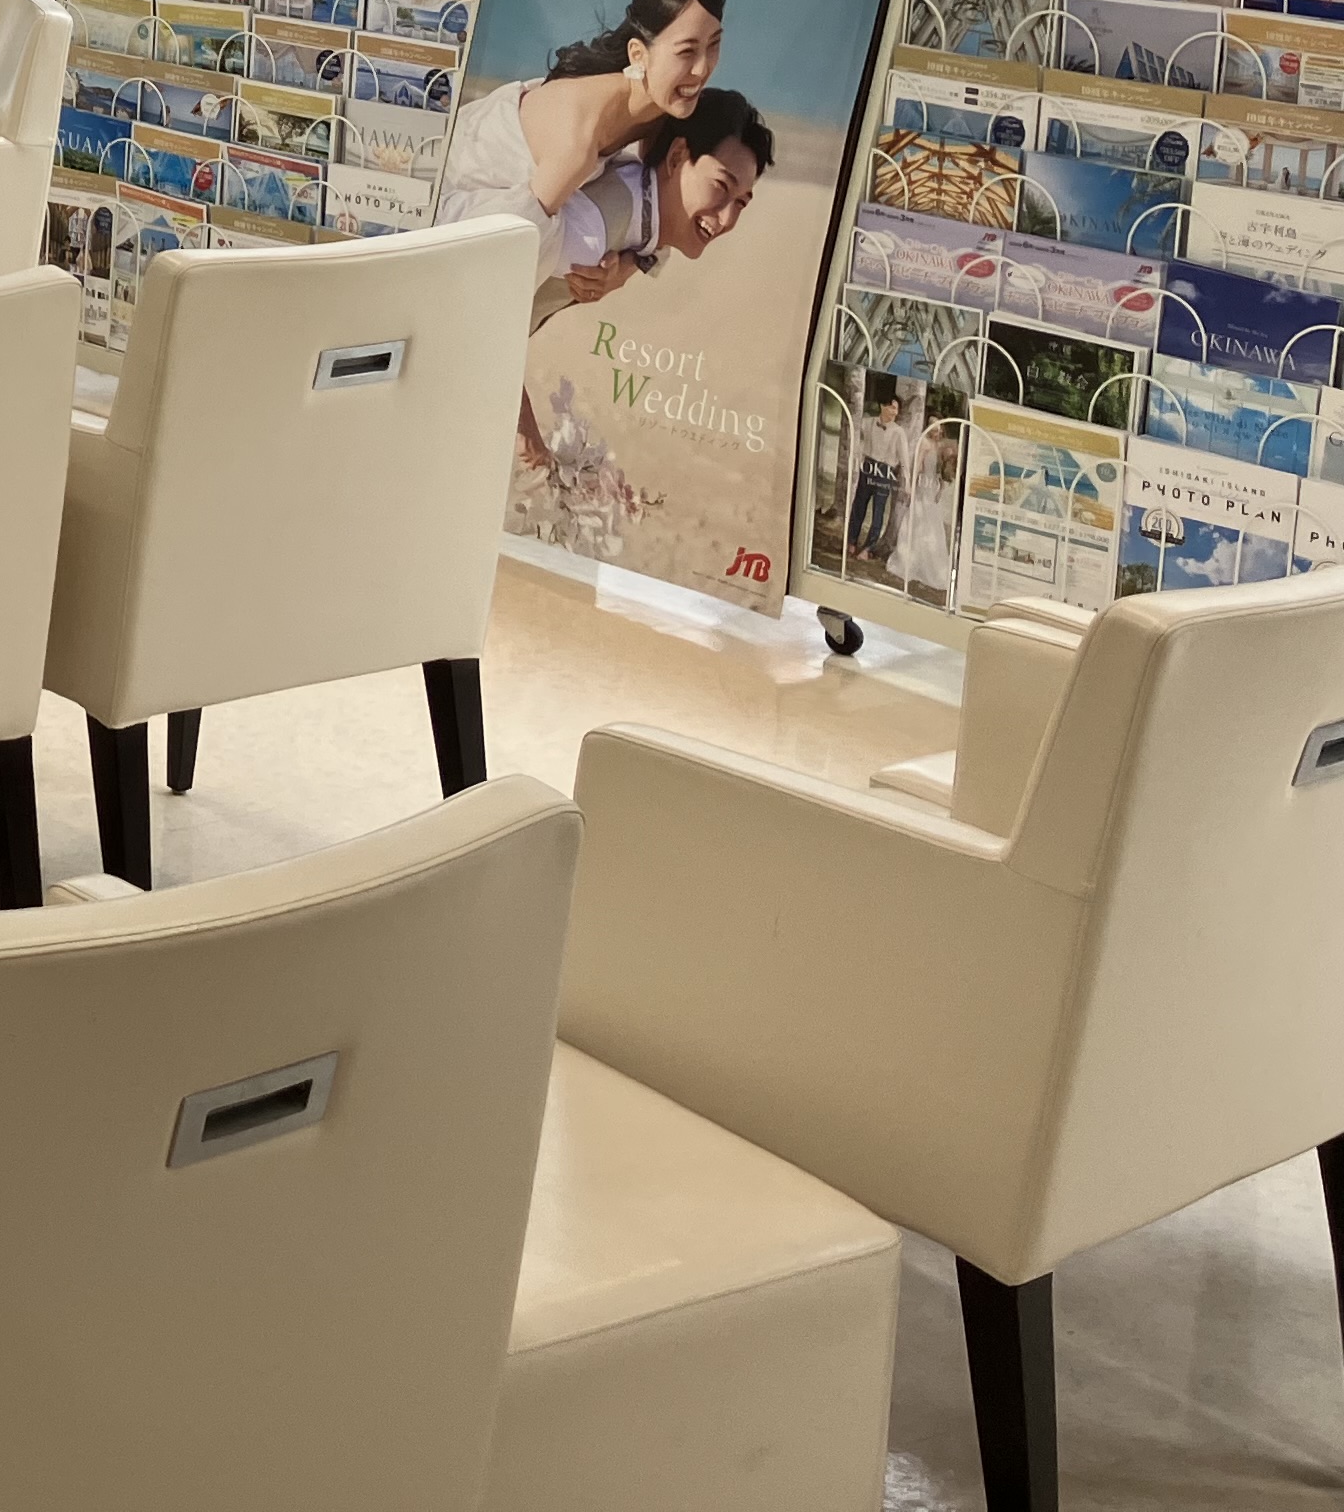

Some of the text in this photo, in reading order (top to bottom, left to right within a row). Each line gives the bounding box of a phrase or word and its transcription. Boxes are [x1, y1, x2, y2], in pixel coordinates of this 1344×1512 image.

[351, 126, 437, 158] HAWAII
[589, 320, 706, 382] Resort
[1190, 330, 1297, 372] OKINAWA
[611, 367, 767, 454] Wedding
[1141, 480, 1282, 524] PHOTO PLAN
[725, 545, 772, 583] JTB
